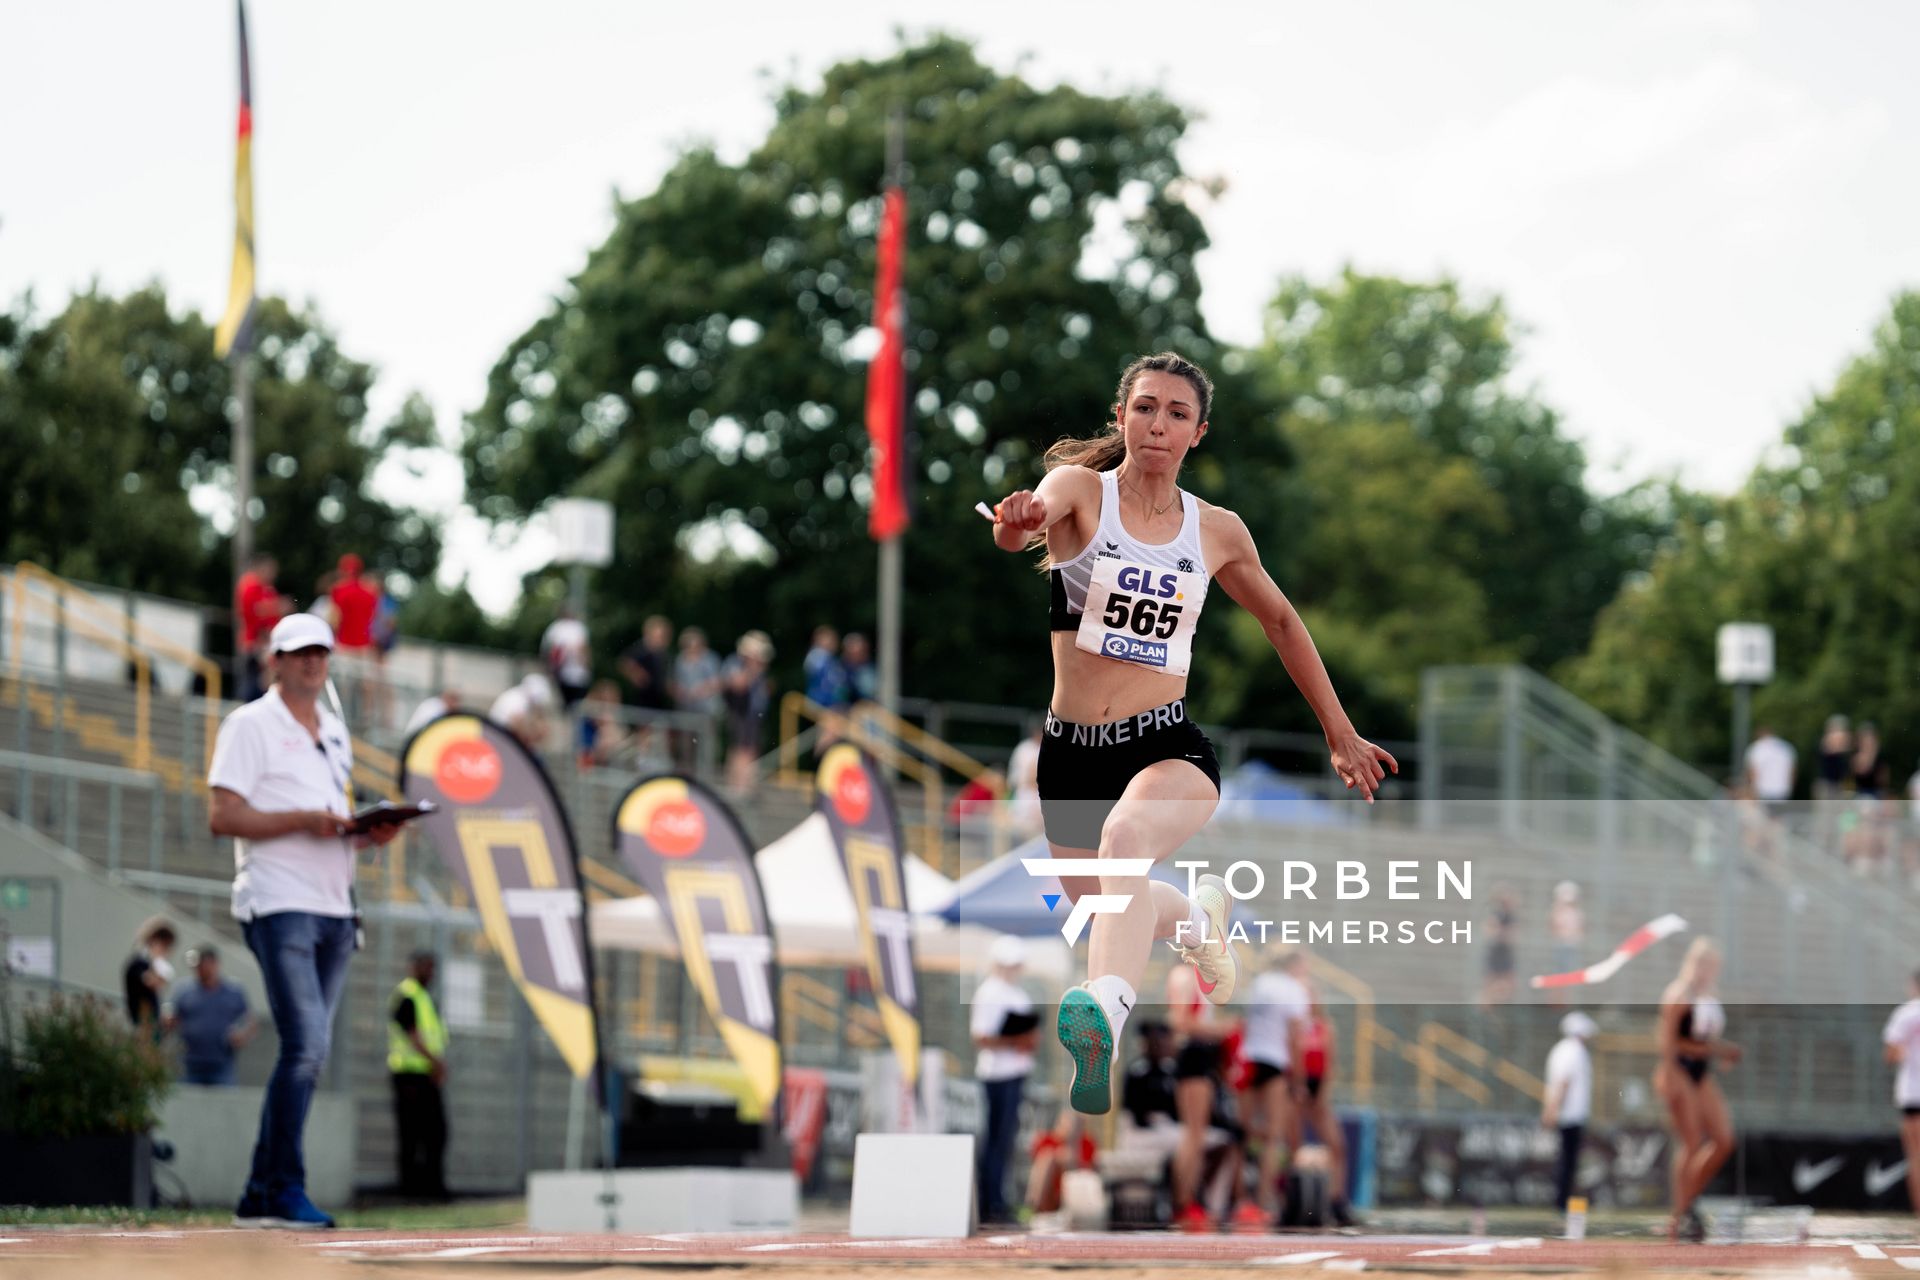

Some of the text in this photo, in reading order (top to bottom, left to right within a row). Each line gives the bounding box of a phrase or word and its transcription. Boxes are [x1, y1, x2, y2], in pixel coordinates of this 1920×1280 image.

[1098, 550, 1121, 560] erima
[1103, 592, 1184, 640] 565
[1130, 642, 1166, 659] PLAN
[1071, 717, 1131, 747] NIKE
[1137, 700, 1185, 737] PRO
